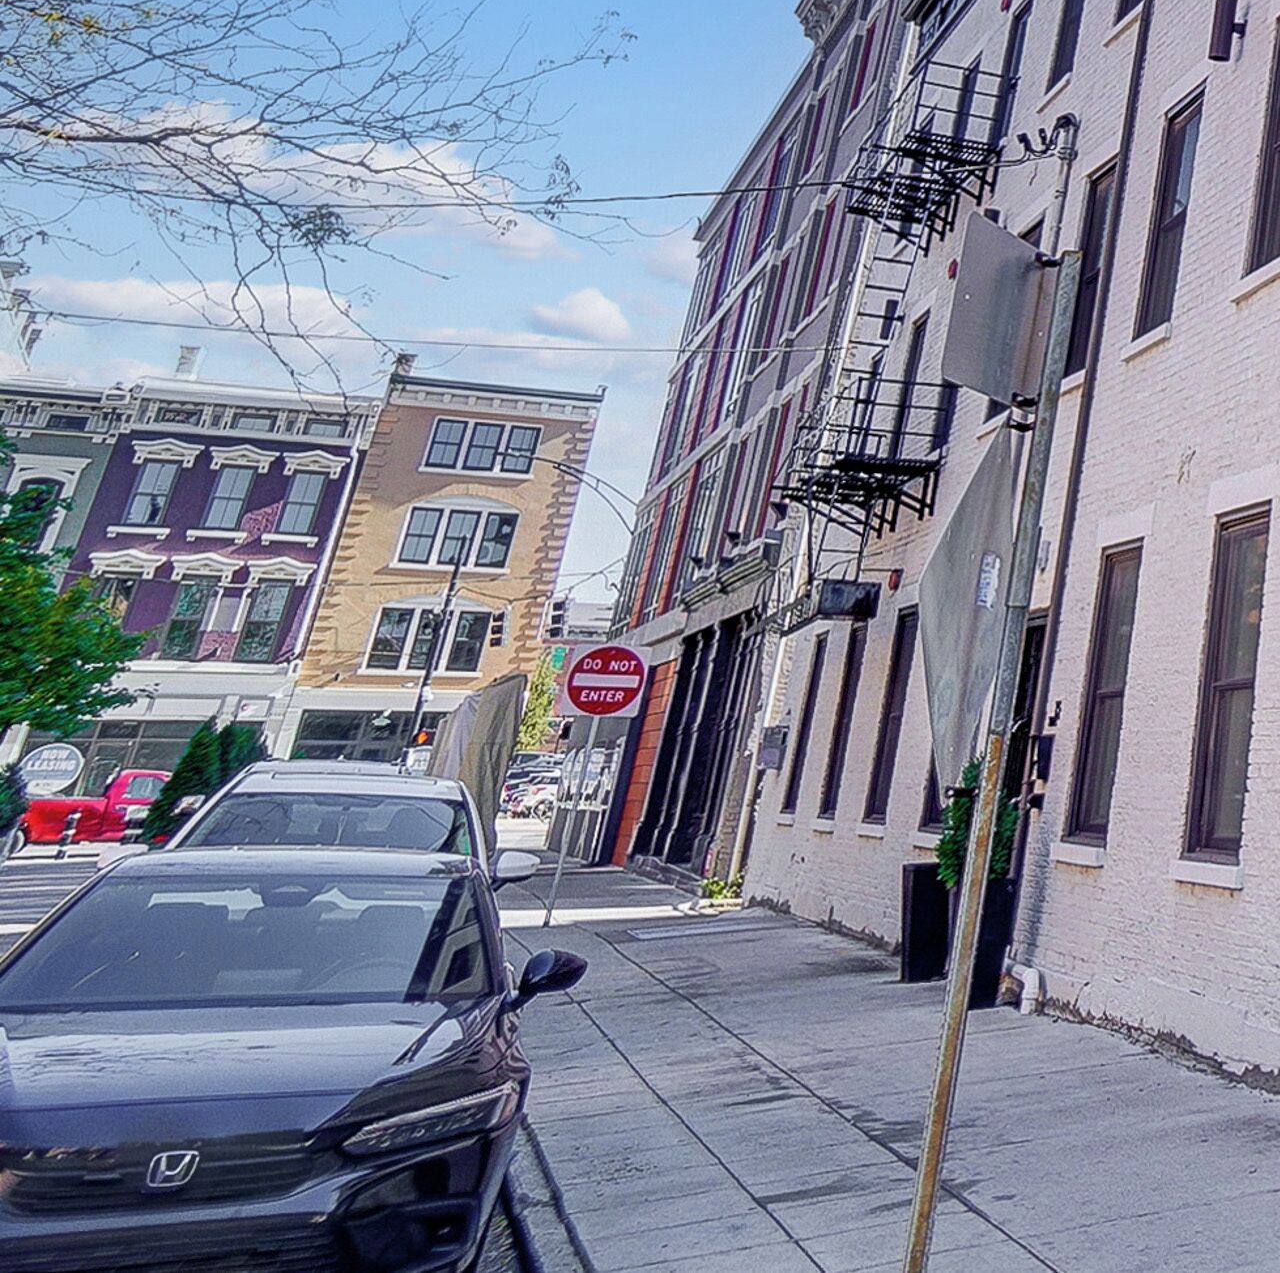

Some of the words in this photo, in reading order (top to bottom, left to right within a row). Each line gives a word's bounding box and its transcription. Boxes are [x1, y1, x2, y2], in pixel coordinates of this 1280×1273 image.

[583, 659, 602, 670] DO
[608, 660, 638, 673] NOT
[580, 689, 625, 702] ENTER
[41, 749, 71, 760] NOW
[27, 760, 77, 772] LEASING
